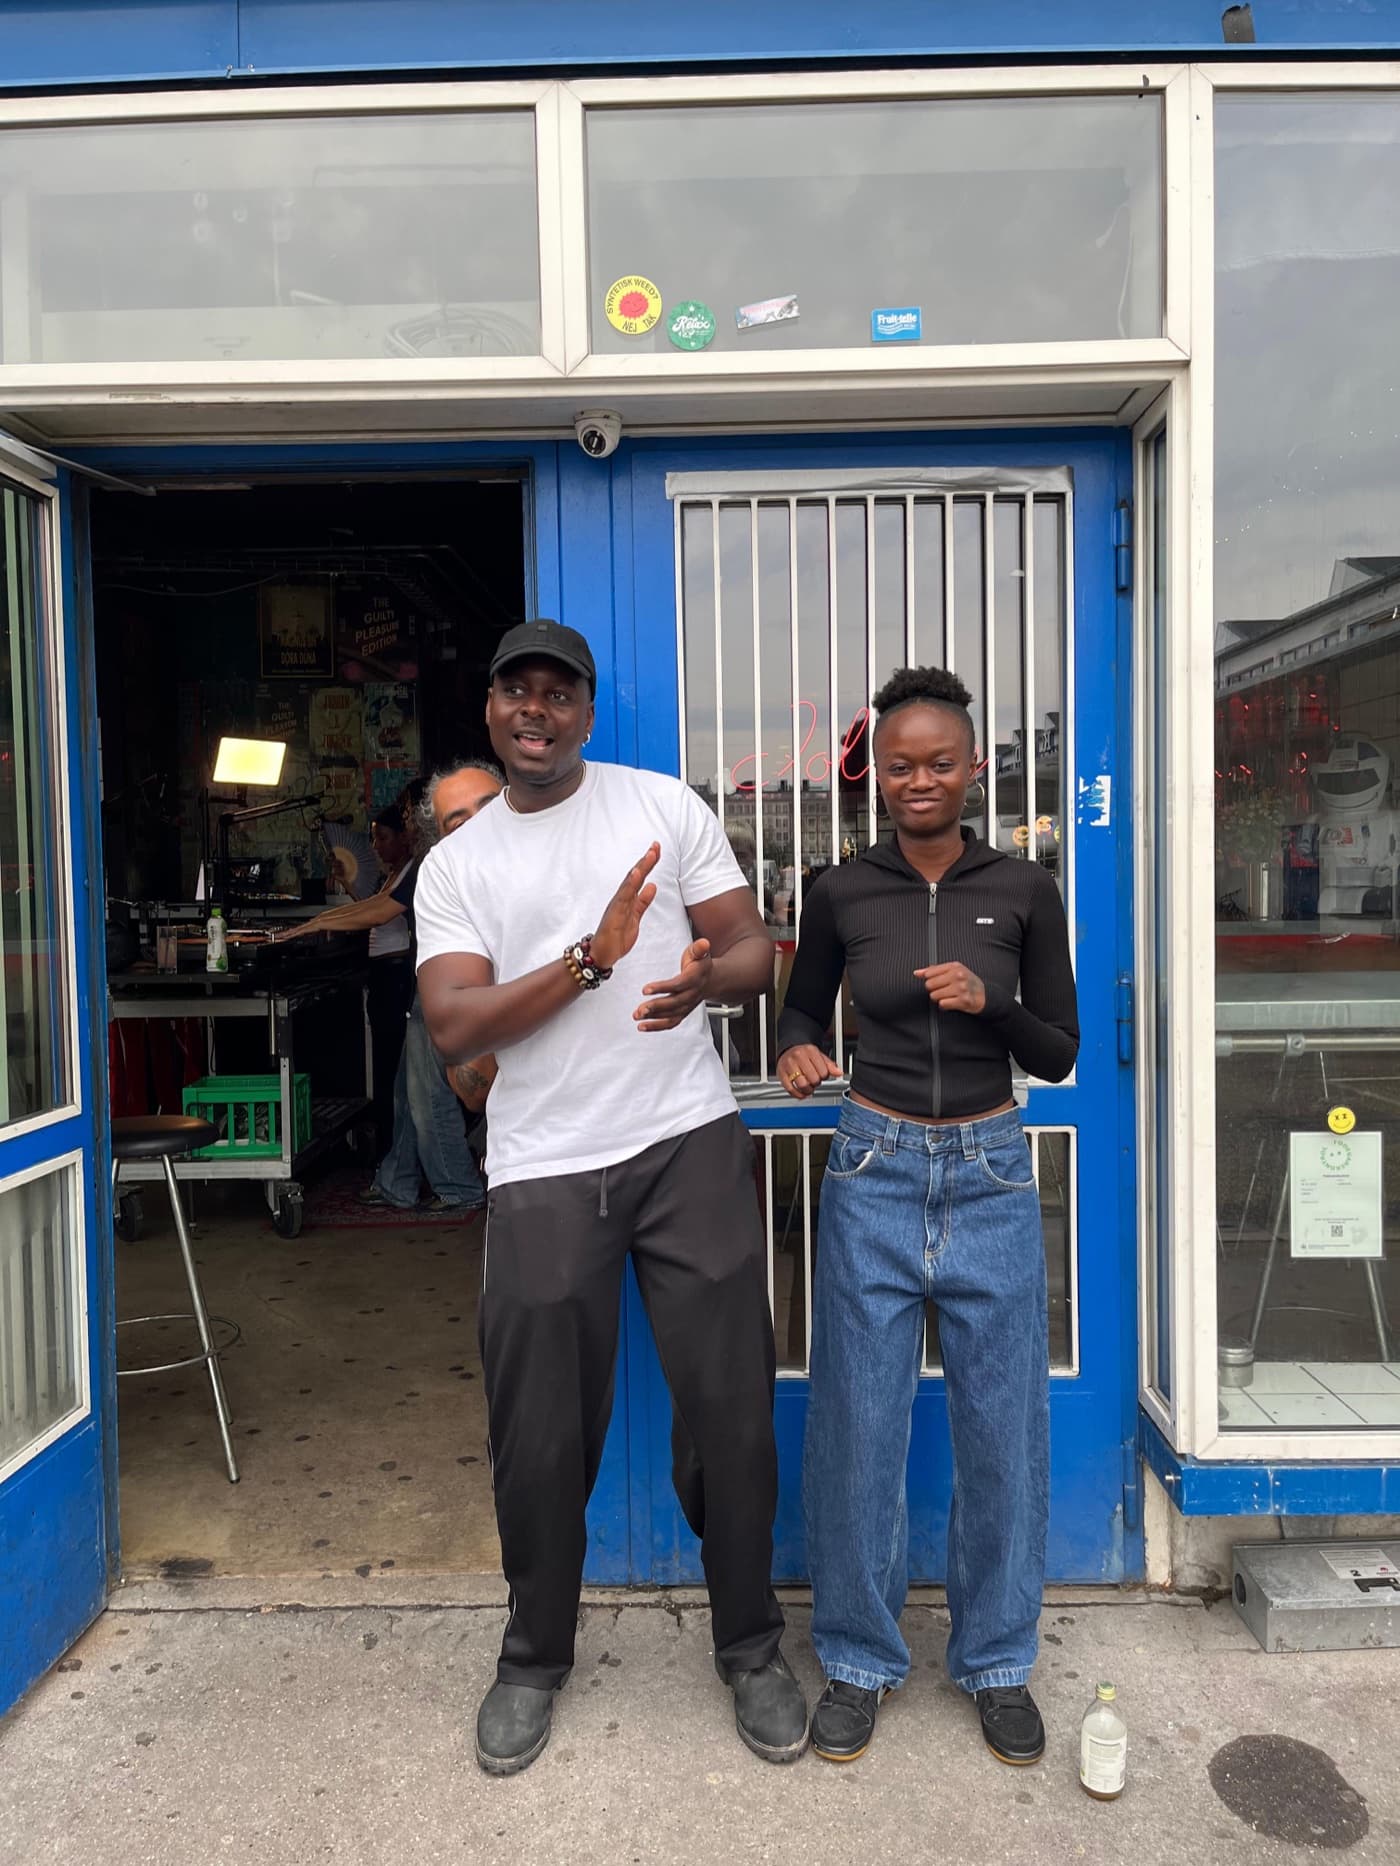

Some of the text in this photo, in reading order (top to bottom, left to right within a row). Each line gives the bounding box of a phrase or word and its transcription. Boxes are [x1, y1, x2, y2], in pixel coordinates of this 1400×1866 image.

[607, 278, 659, 315] SYNTETISK WEED?
[622, 314, 657, 333] NEJ TAK
[373, 596, 391, 609] THE
[363, 609, 396, 625] GUILTY
[361, 634, 398, 657] EDITION
